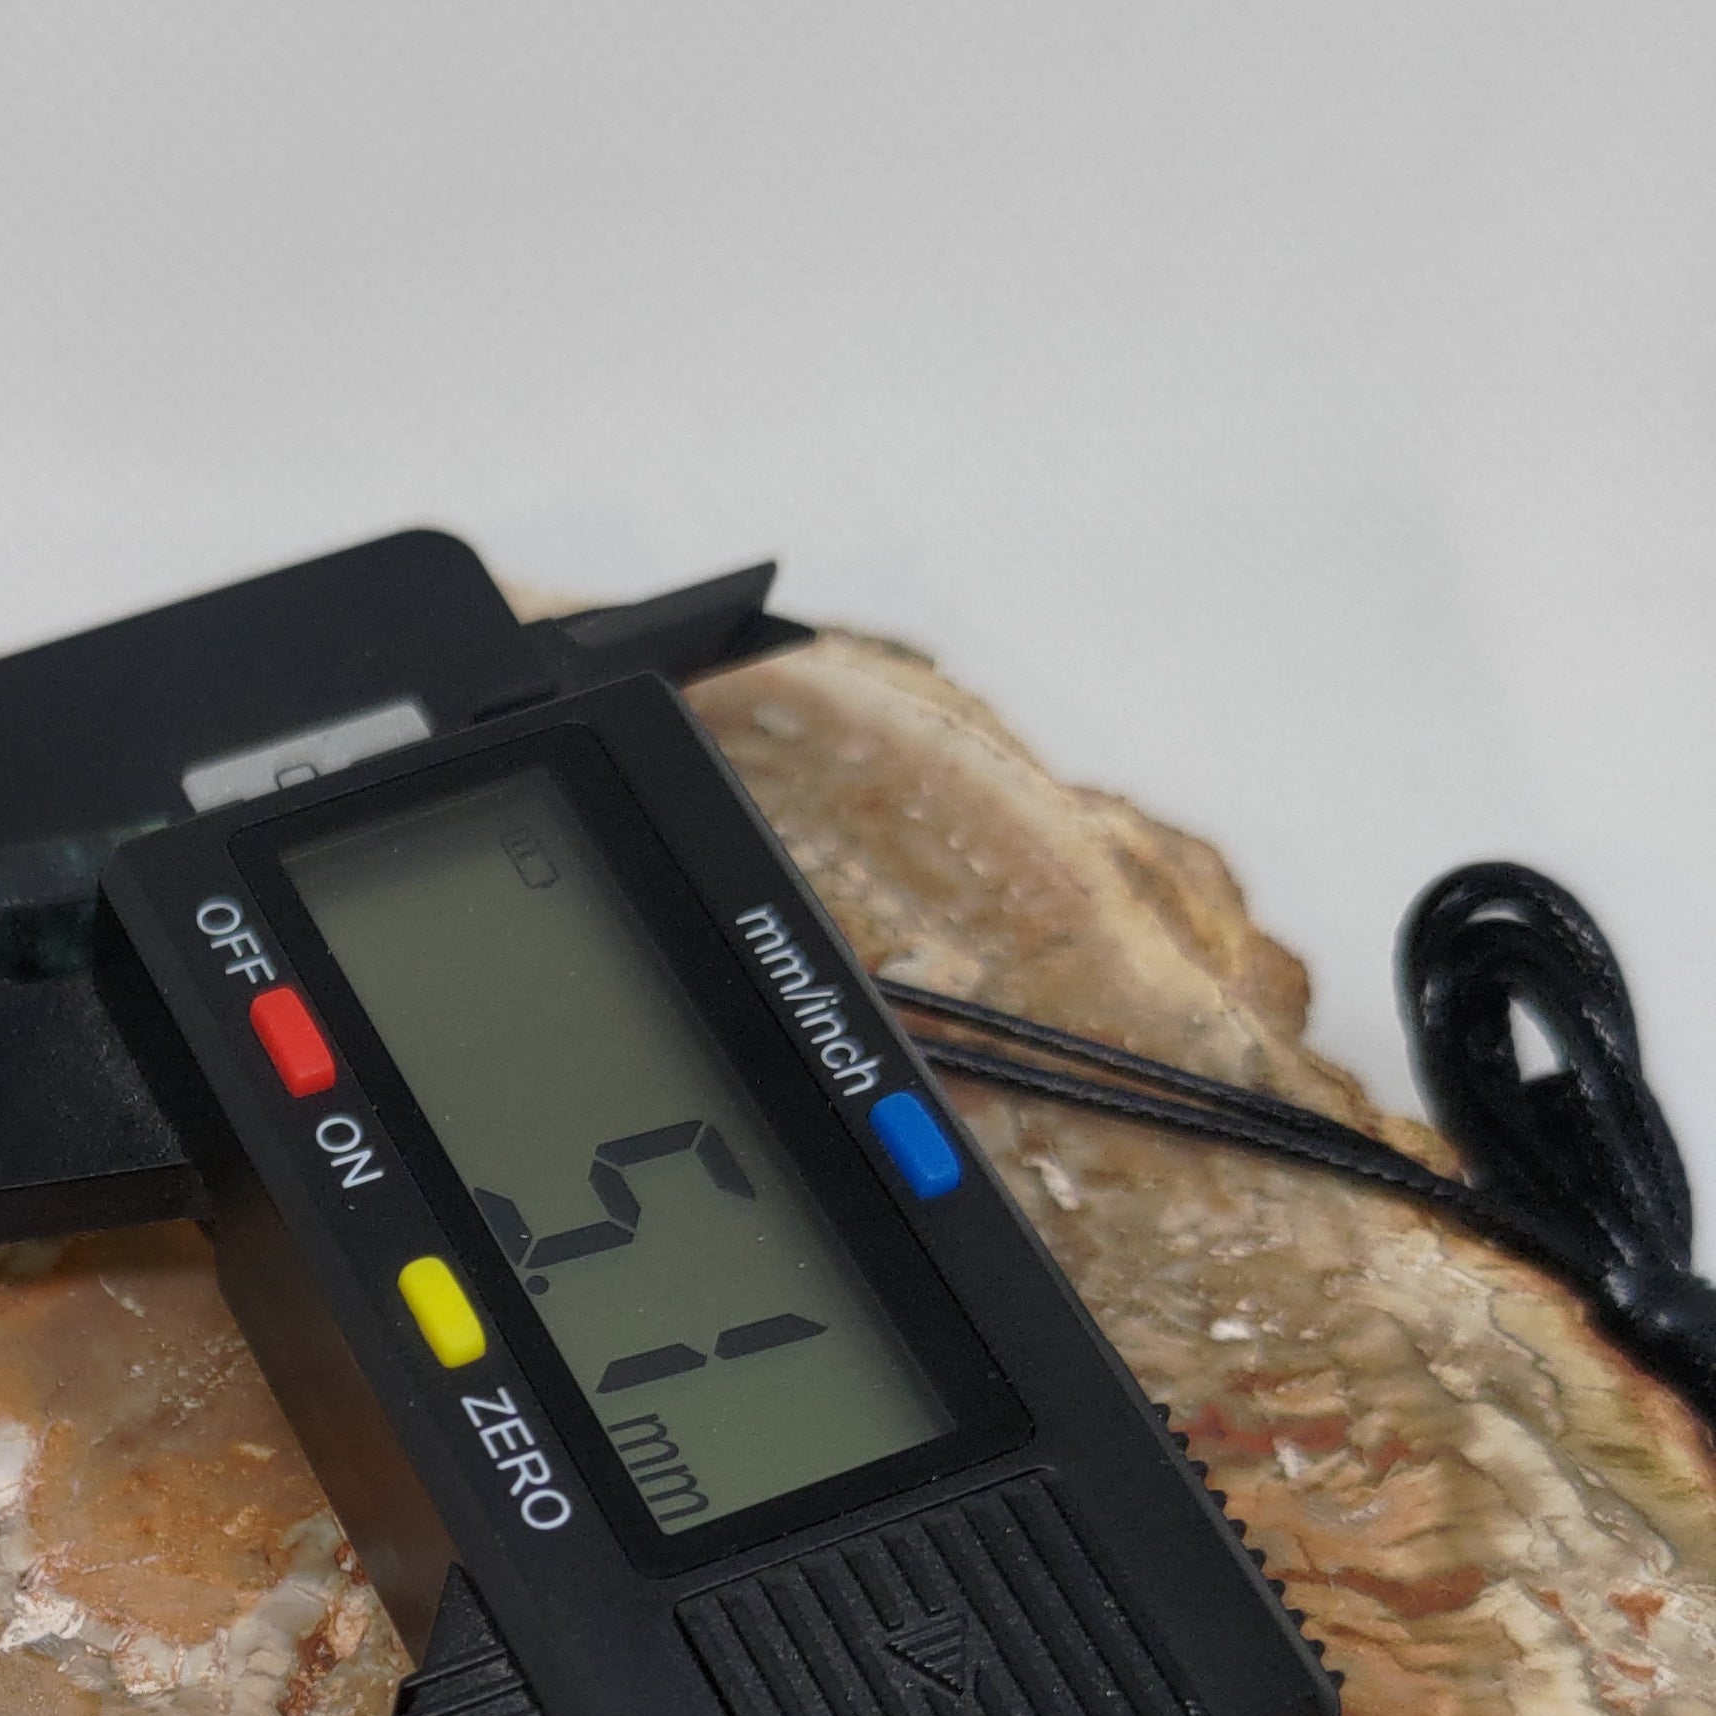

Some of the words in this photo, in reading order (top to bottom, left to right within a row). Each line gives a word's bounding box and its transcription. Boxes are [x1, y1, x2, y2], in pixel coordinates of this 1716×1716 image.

[195, 896, 276, 986] OFF
[734, 904, 882, 1098] mm/inch
[314, 1113, 384, 1191] ON
[473, 1119, 828, 1394] 5.1
[461, 1387, 572, 1532] ZERO
[606, 1412, 710, 1526] mm
